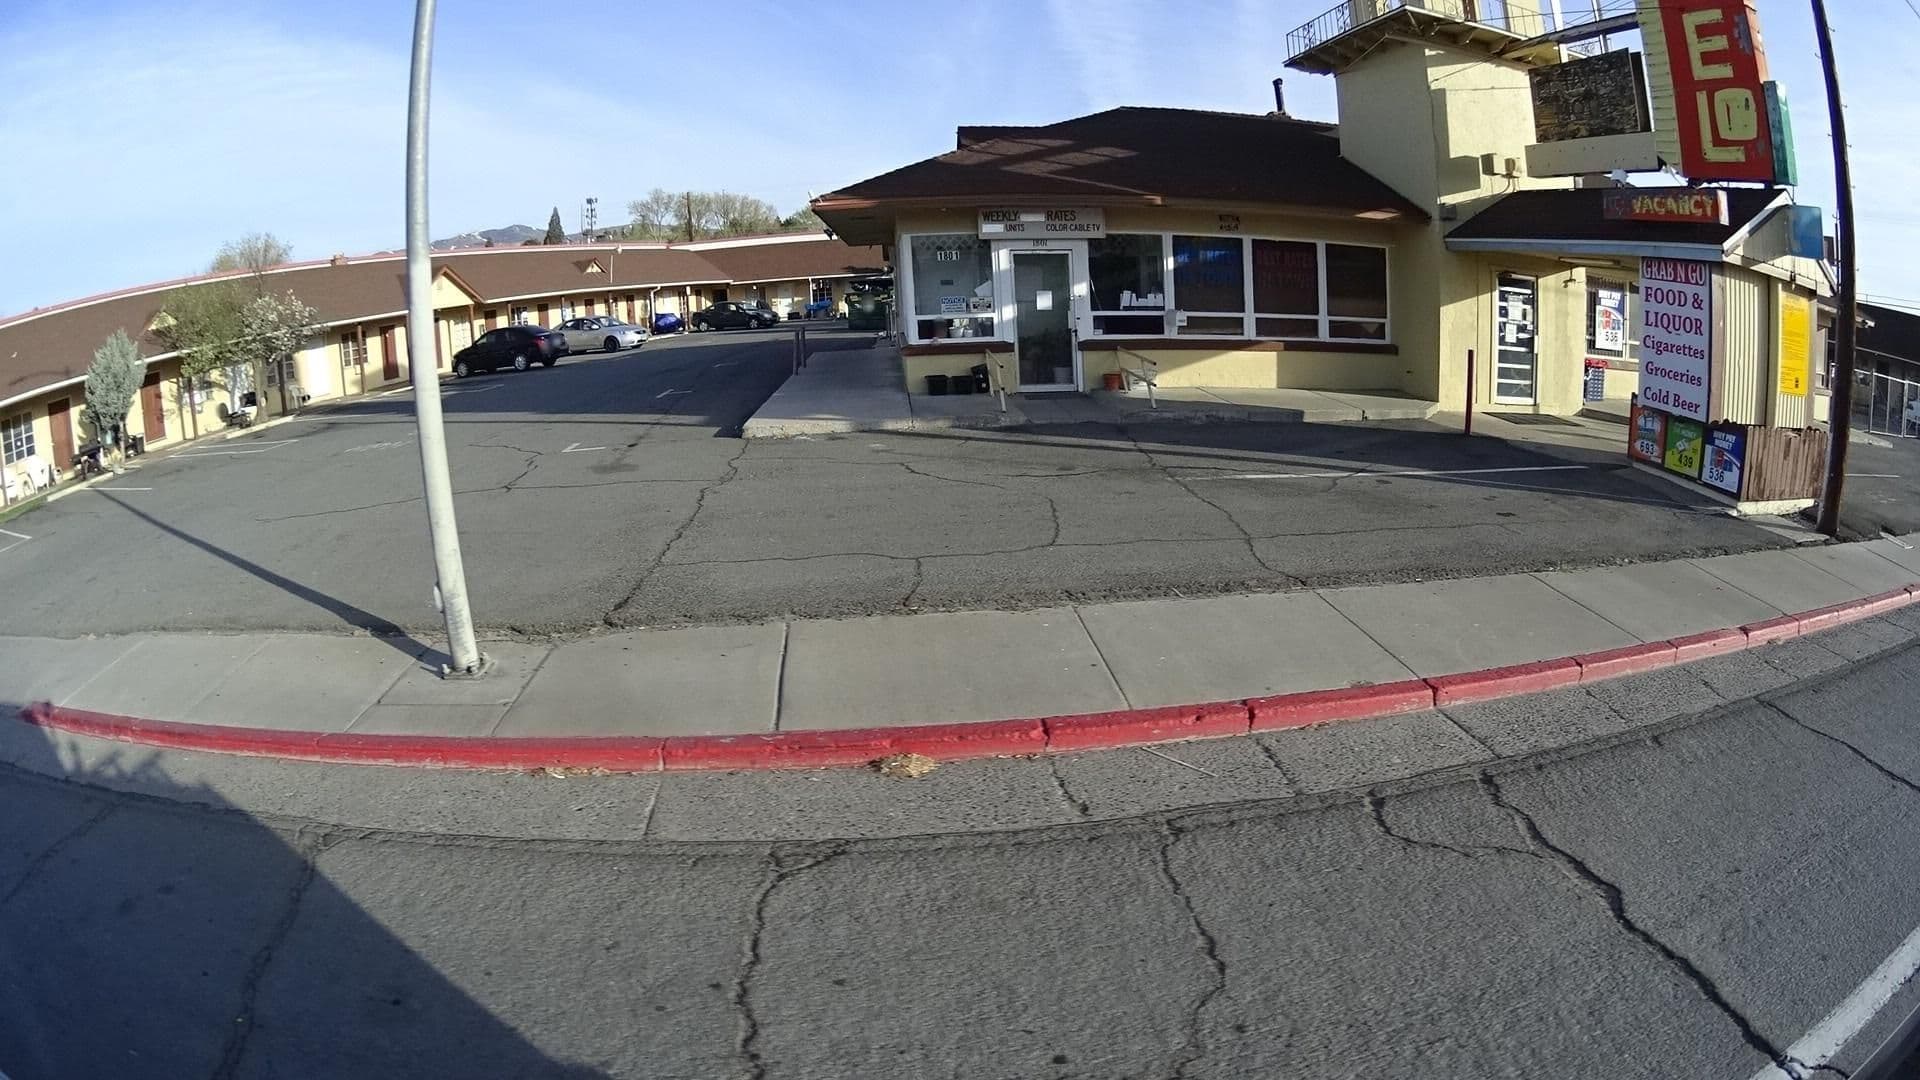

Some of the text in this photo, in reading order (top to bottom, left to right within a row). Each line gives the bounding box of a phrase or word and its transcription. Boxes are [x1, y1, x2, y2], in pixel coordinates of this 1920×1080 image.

[982, 210, 1077, 222] WEEKLY RATES
[1632, 193, 1714, 217] VACANCY
[1005, 223, 1025, 232] UNITS
[939, 251, 959, 260] 1801
[1643, 259, 1706, 285] GRAB N GO
[1644, 286, 1704, 311] FOOD &
[1644, 310, 1704, 336] LIQUOR
[1643, 334, 1705, 360] Cigarettes
[1645, 361, 1703, 387] Groceries
[1643, 386, 1701, 414] Cold Beer
[1639, 440, 1655, 455] 693
[1678, 454, 1694, 468] 439
[1708, 467, 1725, 483] 536
